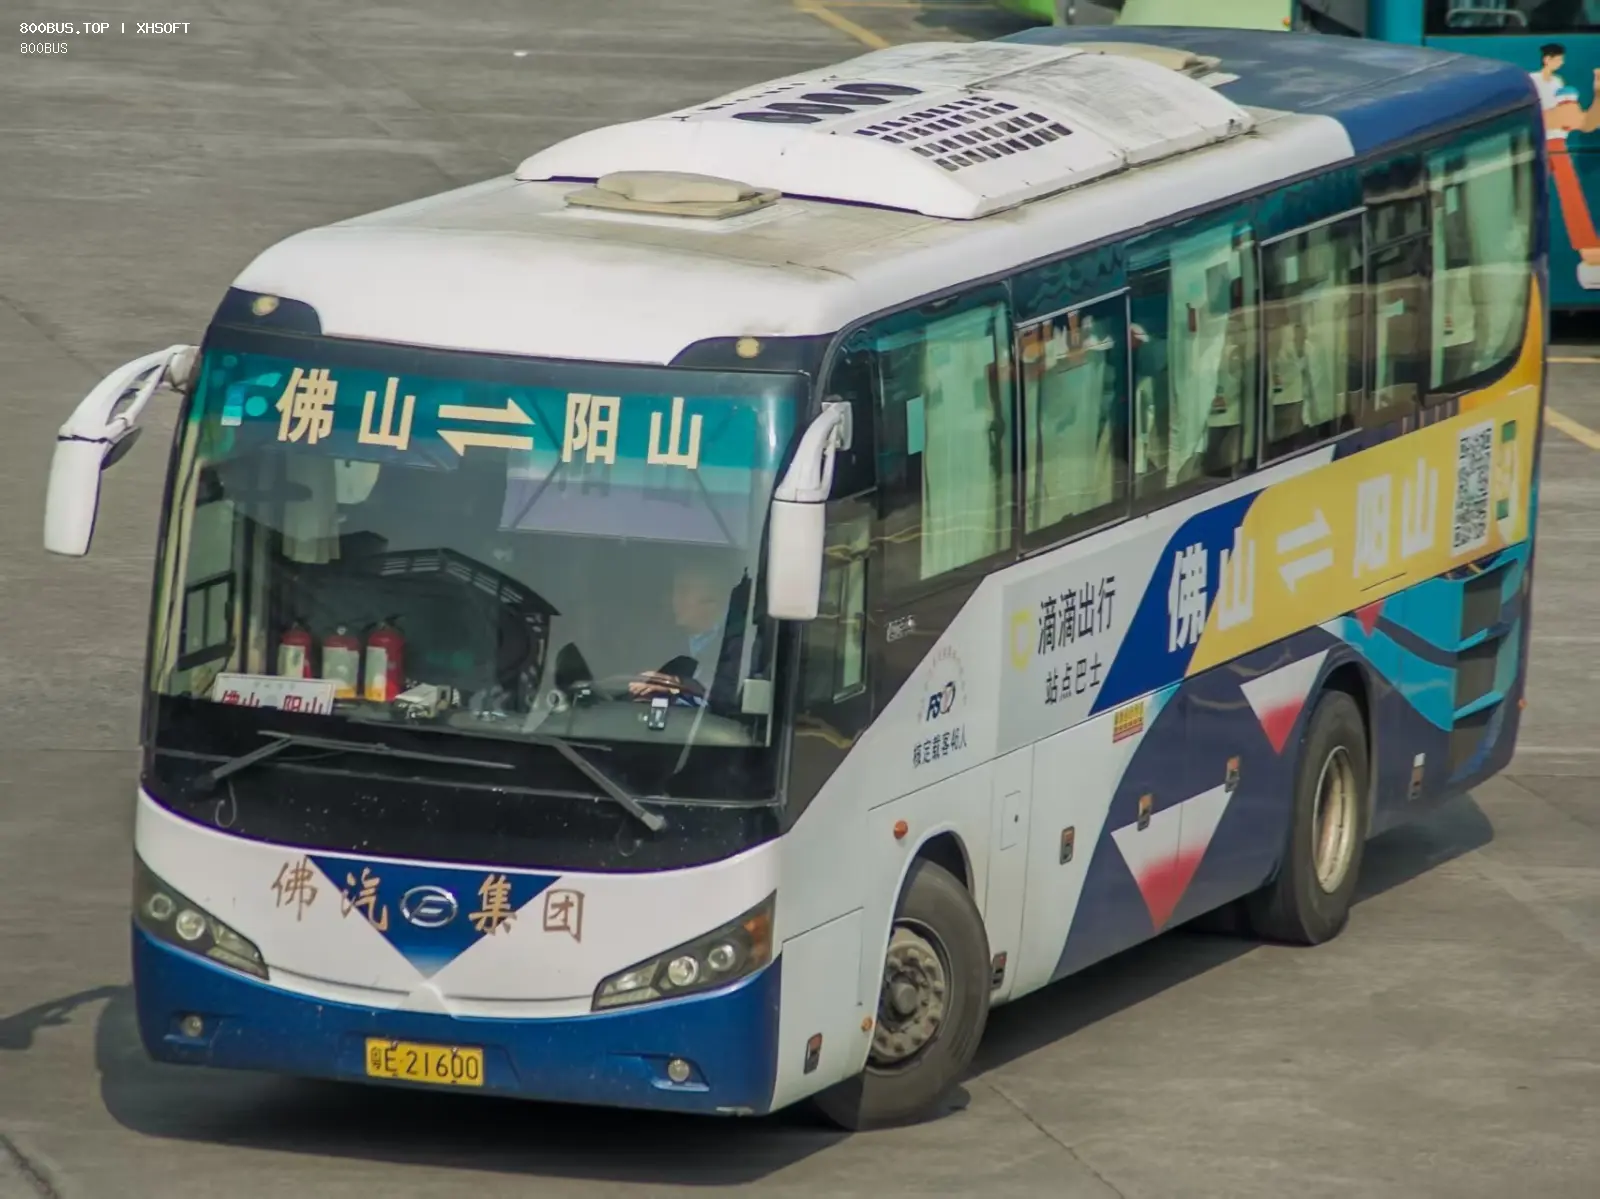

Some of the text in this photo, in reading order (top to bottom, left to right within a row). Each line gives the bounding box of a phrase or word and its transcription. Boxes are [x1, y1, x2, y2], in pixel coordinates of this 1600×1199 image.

[276, 367, 704, 470] 佛山 阳山
[1168, 457, 1439, 653] 佛山 阳山
[1038, 575, 1116, 655] 滴滴出行
[1045, 652, 1102, 705] 站点巴士
[469, 873, 585, 943] 集团
